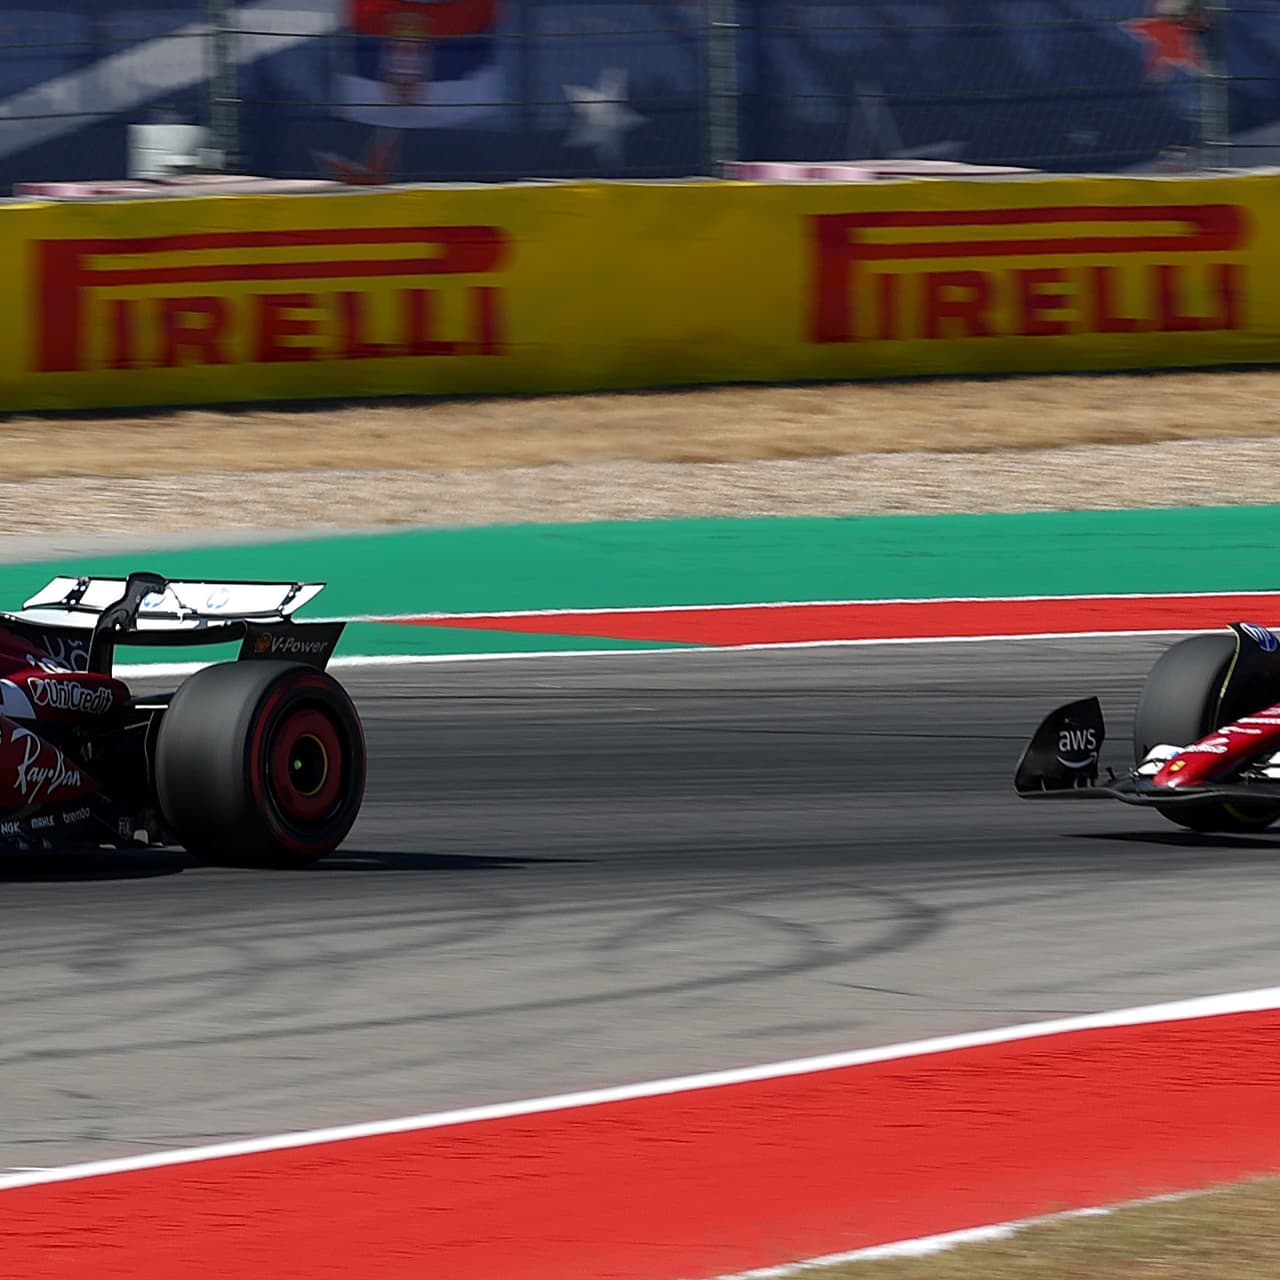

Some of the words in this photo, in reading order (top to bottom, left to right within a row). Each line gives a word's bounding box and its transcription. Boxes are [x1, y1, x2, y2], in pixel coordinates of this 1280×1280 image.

[804, 204, 1256, 344] PIRELLI
[29, 226, 513, 372] PIRELLI
[271, 636, 329, 653] V-Power
[44, 678, 113, 714] UniCredit
[1058, 729, 1097, 752] aws
